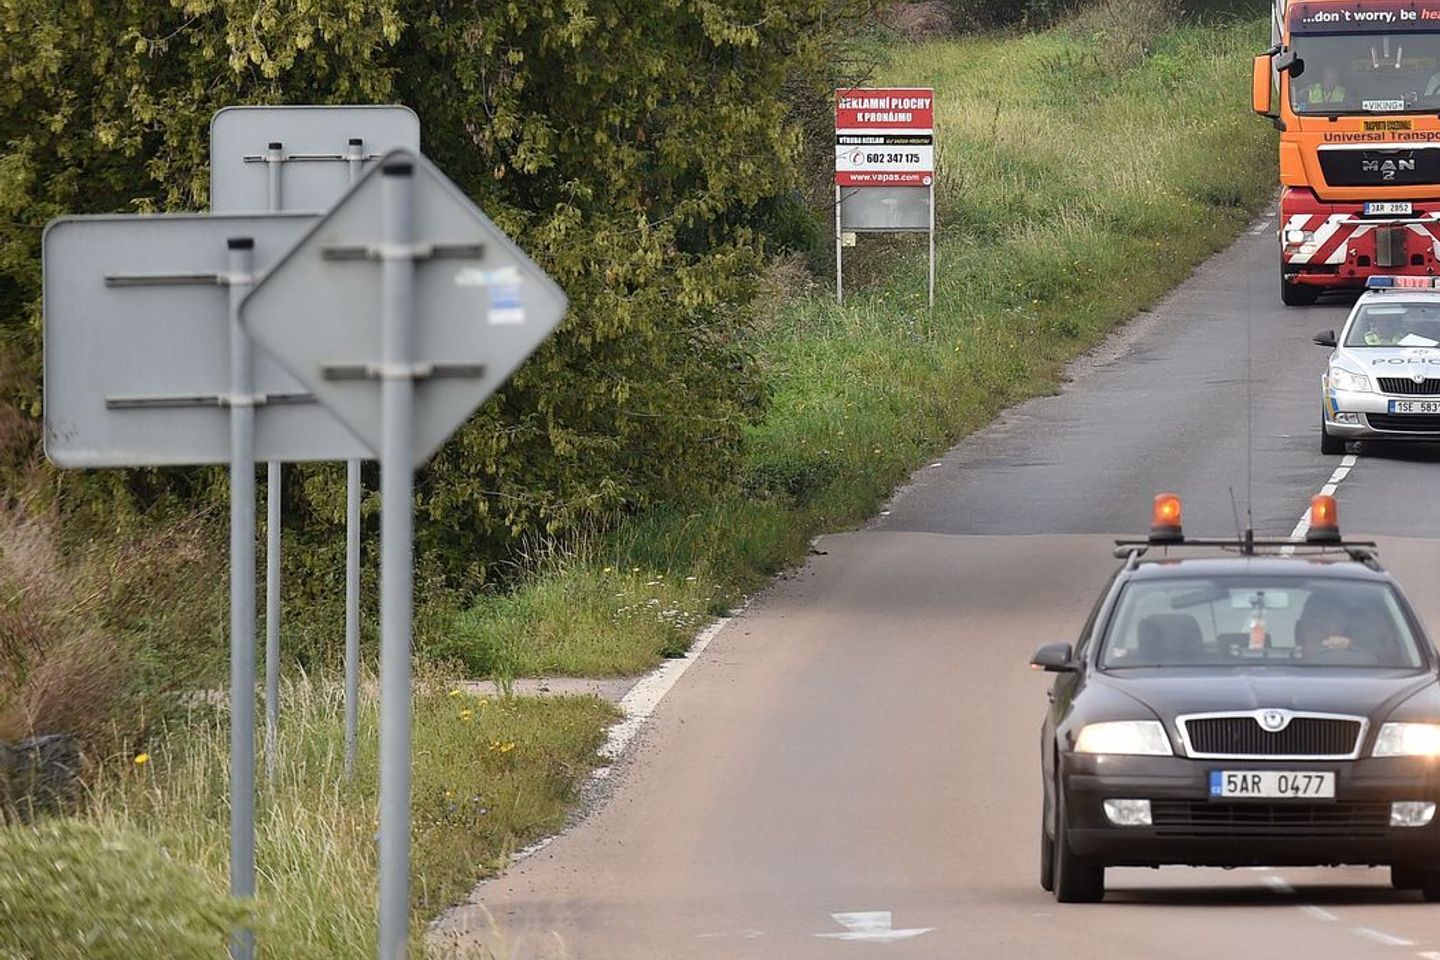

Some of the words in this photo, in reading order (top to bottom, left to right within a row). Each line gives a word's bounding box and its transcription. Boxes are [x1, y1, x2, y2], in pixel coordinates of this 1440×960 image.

[1354, 11, 1396, 23] worry,
[1400, 9, 1417, 20] be
[891, 98, 931, 109] PLOCHY
[1368, 101, 1399, 109] VIKING
[857, 112, 863, 122] K
[1324, 132, 1385, 142] Universal
[866, 153, 885, 163] 602
[887, 153, 904, 163] 347
[905, 153, 920, 163] 175
[1362, 159, 1415, 171] MAN
[850, 174, 920, 183] www.vapas.com
[1227, 774, 1261, 793] 5AR
[1278, 775, 1325, 794] 0477
